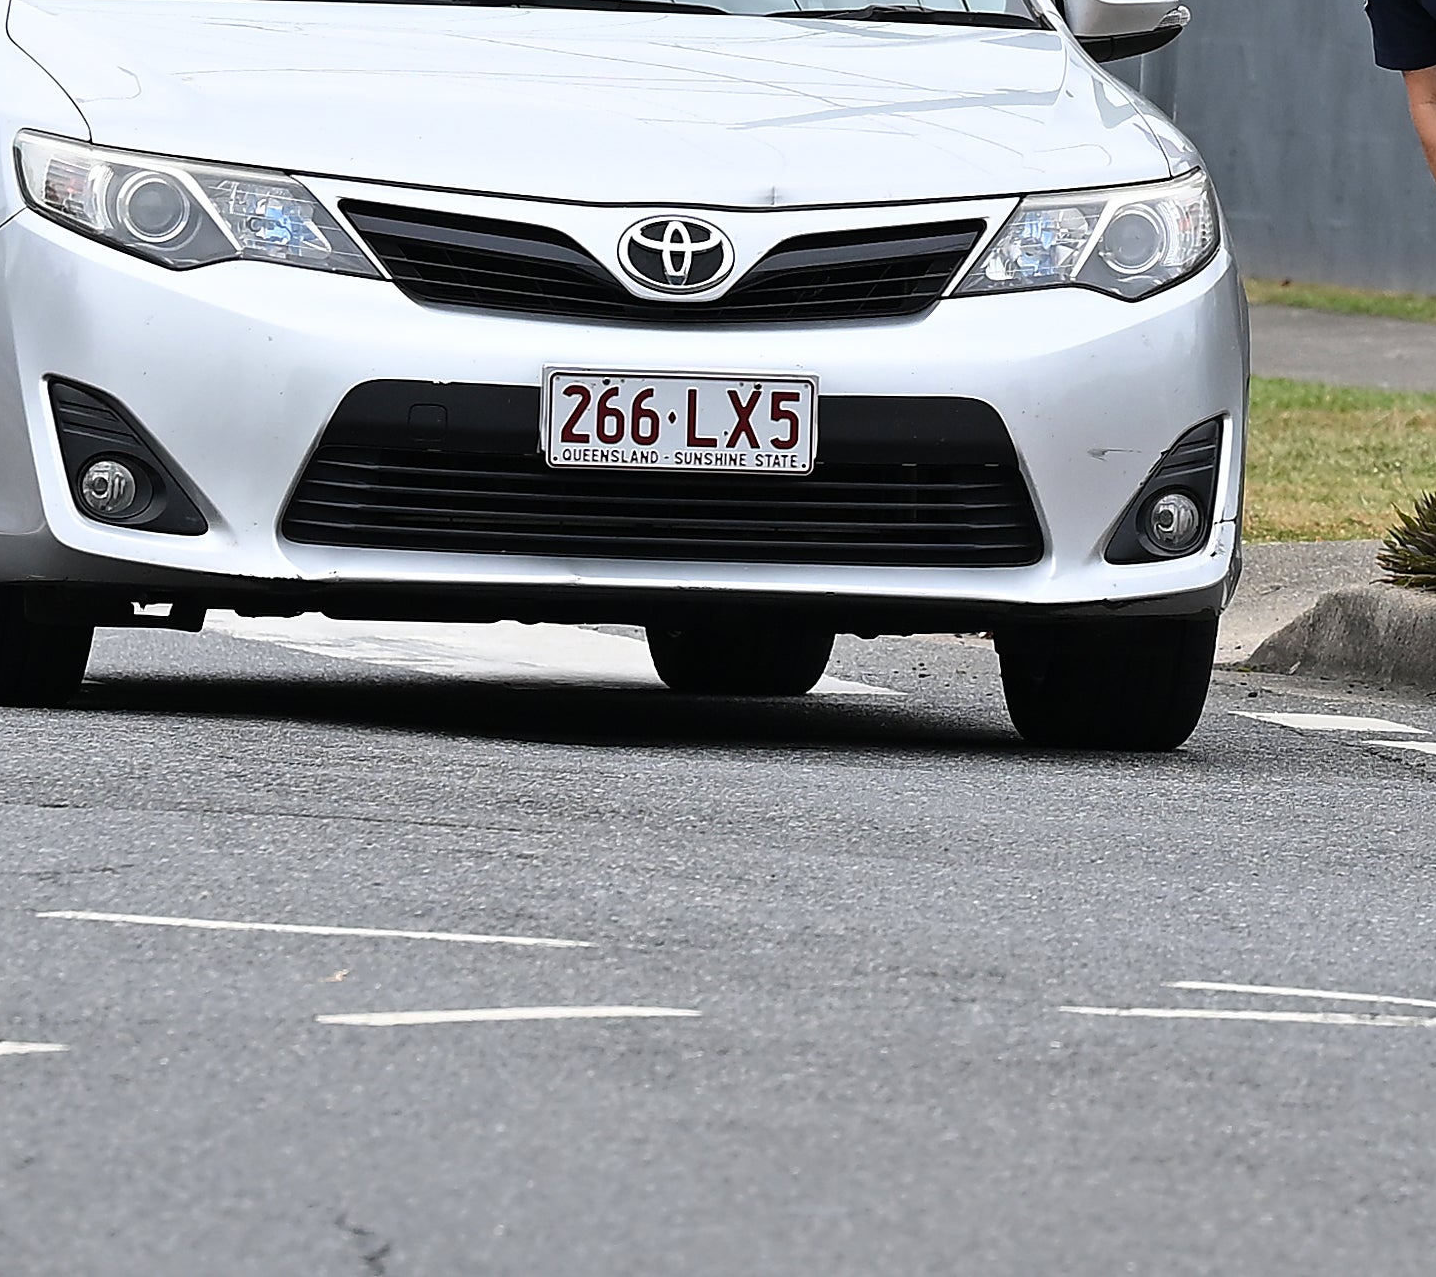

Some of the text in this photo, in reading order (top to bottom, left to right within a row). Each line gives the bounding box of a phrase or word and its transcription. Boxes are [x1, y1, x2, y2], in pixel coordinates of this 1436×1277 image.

[561, 447, 660, 465] QUEENSLAND
[673, 450, 748, 467] SUNSHINE
[754, 453, 799, 469] STATE
